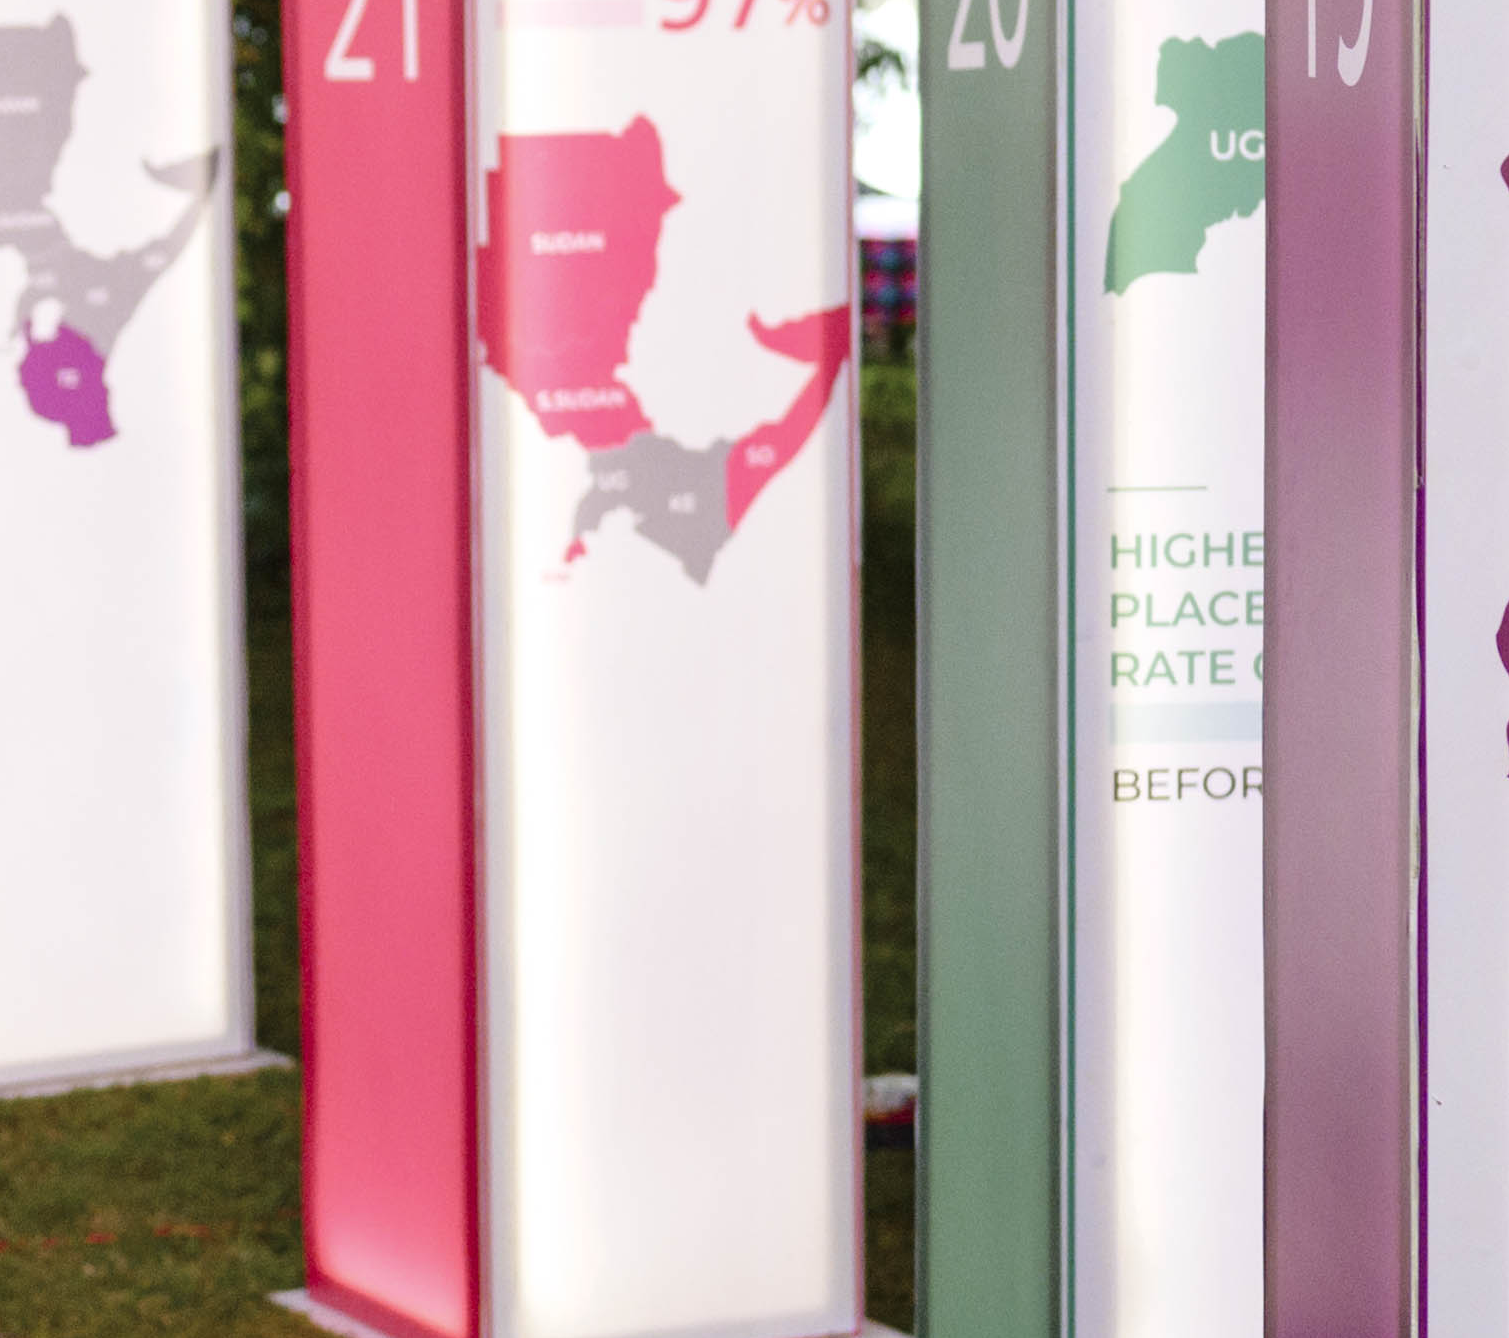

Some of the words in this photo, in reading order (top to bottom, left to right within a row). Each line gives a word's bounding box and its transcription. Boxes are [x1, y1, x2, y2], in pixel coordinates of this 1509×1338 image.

[1210, 130, 1265, 161] UG
[529, 230, 605, 255] SUDAN
[1111, 650, 1236, 688] RATE
